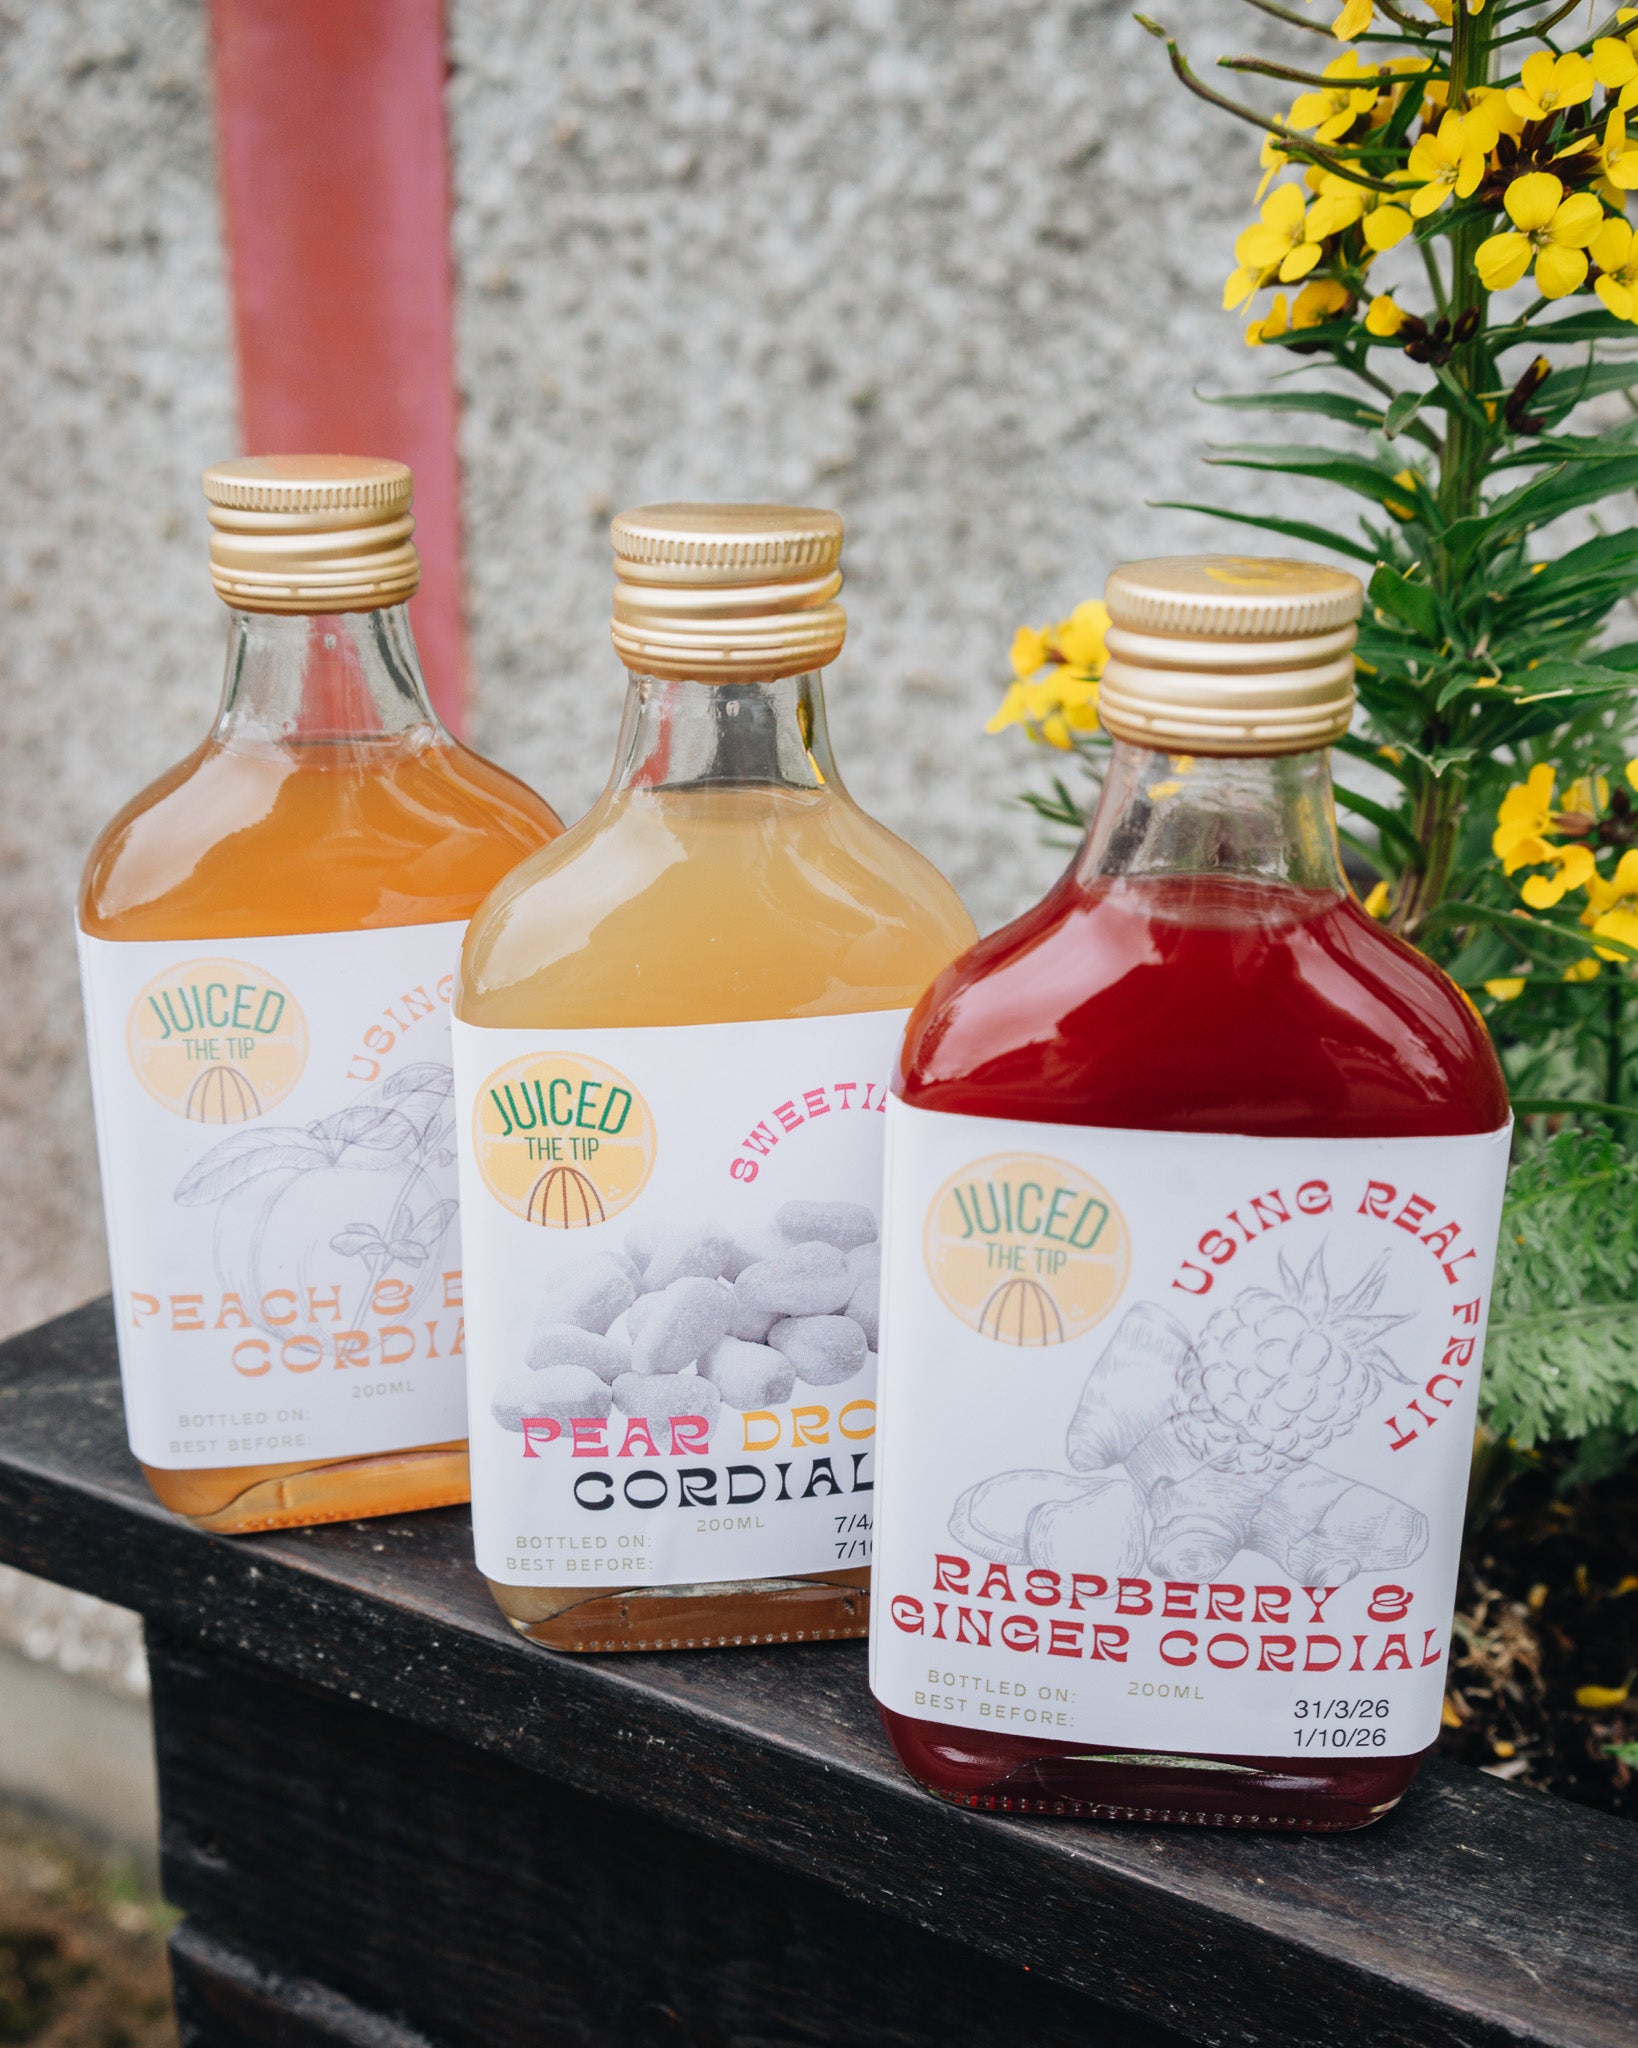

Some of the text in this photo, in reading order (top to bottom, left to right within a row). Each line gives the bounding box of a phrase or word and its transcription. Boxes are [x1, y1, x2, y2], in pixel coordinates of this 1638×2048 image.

[148, 982, 286, 1041] JUICED
[182, 1035, 256, 1061] THE TIP
[489, 1077, 634, 1137] JUICED
[524, 1136, 600, 1162] THE TIP
[952, 1181, 1111, 1251] JUICED
[985, 1241, 1069, 1276] THE TIP
[128, 1284, 343, 1332] PEACH
[371, 1278, 415, 1316] &
[1172, 1179, 1482, 1452] USING REAL FRUIT
[351, 1380, 416, 1399] 200ML
[178, 1408, 312, 1428] BOTTLED ON:
[169, 1433, 312, 1454] BEST BEFORE:
[521, 1414, 711, 1459] PEAR
[572, 1452, 875, 1512] CORDIAL
[696, 1516, 765, 1533] 200ML
[516, 1534, 653, 1550] BOTTLED ON:
[833, 1539, 874, 1560] 7/1
[506, 1556, 654, 1573] BEST BEFORE:
[932, 1553, 1415, 1624] RASPBERRY &
[890, 1594, 1443, 1673] GINGER CORDIAL
[926, 1668, 1077, 1704] BOTTLED ON:
[1126, 1680, 1206, 1701] 200ML
[913, 1690, 1076, 1728] BEST BEFORE:
[1293, 1698, 1391, 1720] 31/3/26
[1293, 1727, 1388, 1749] 1/10/26
